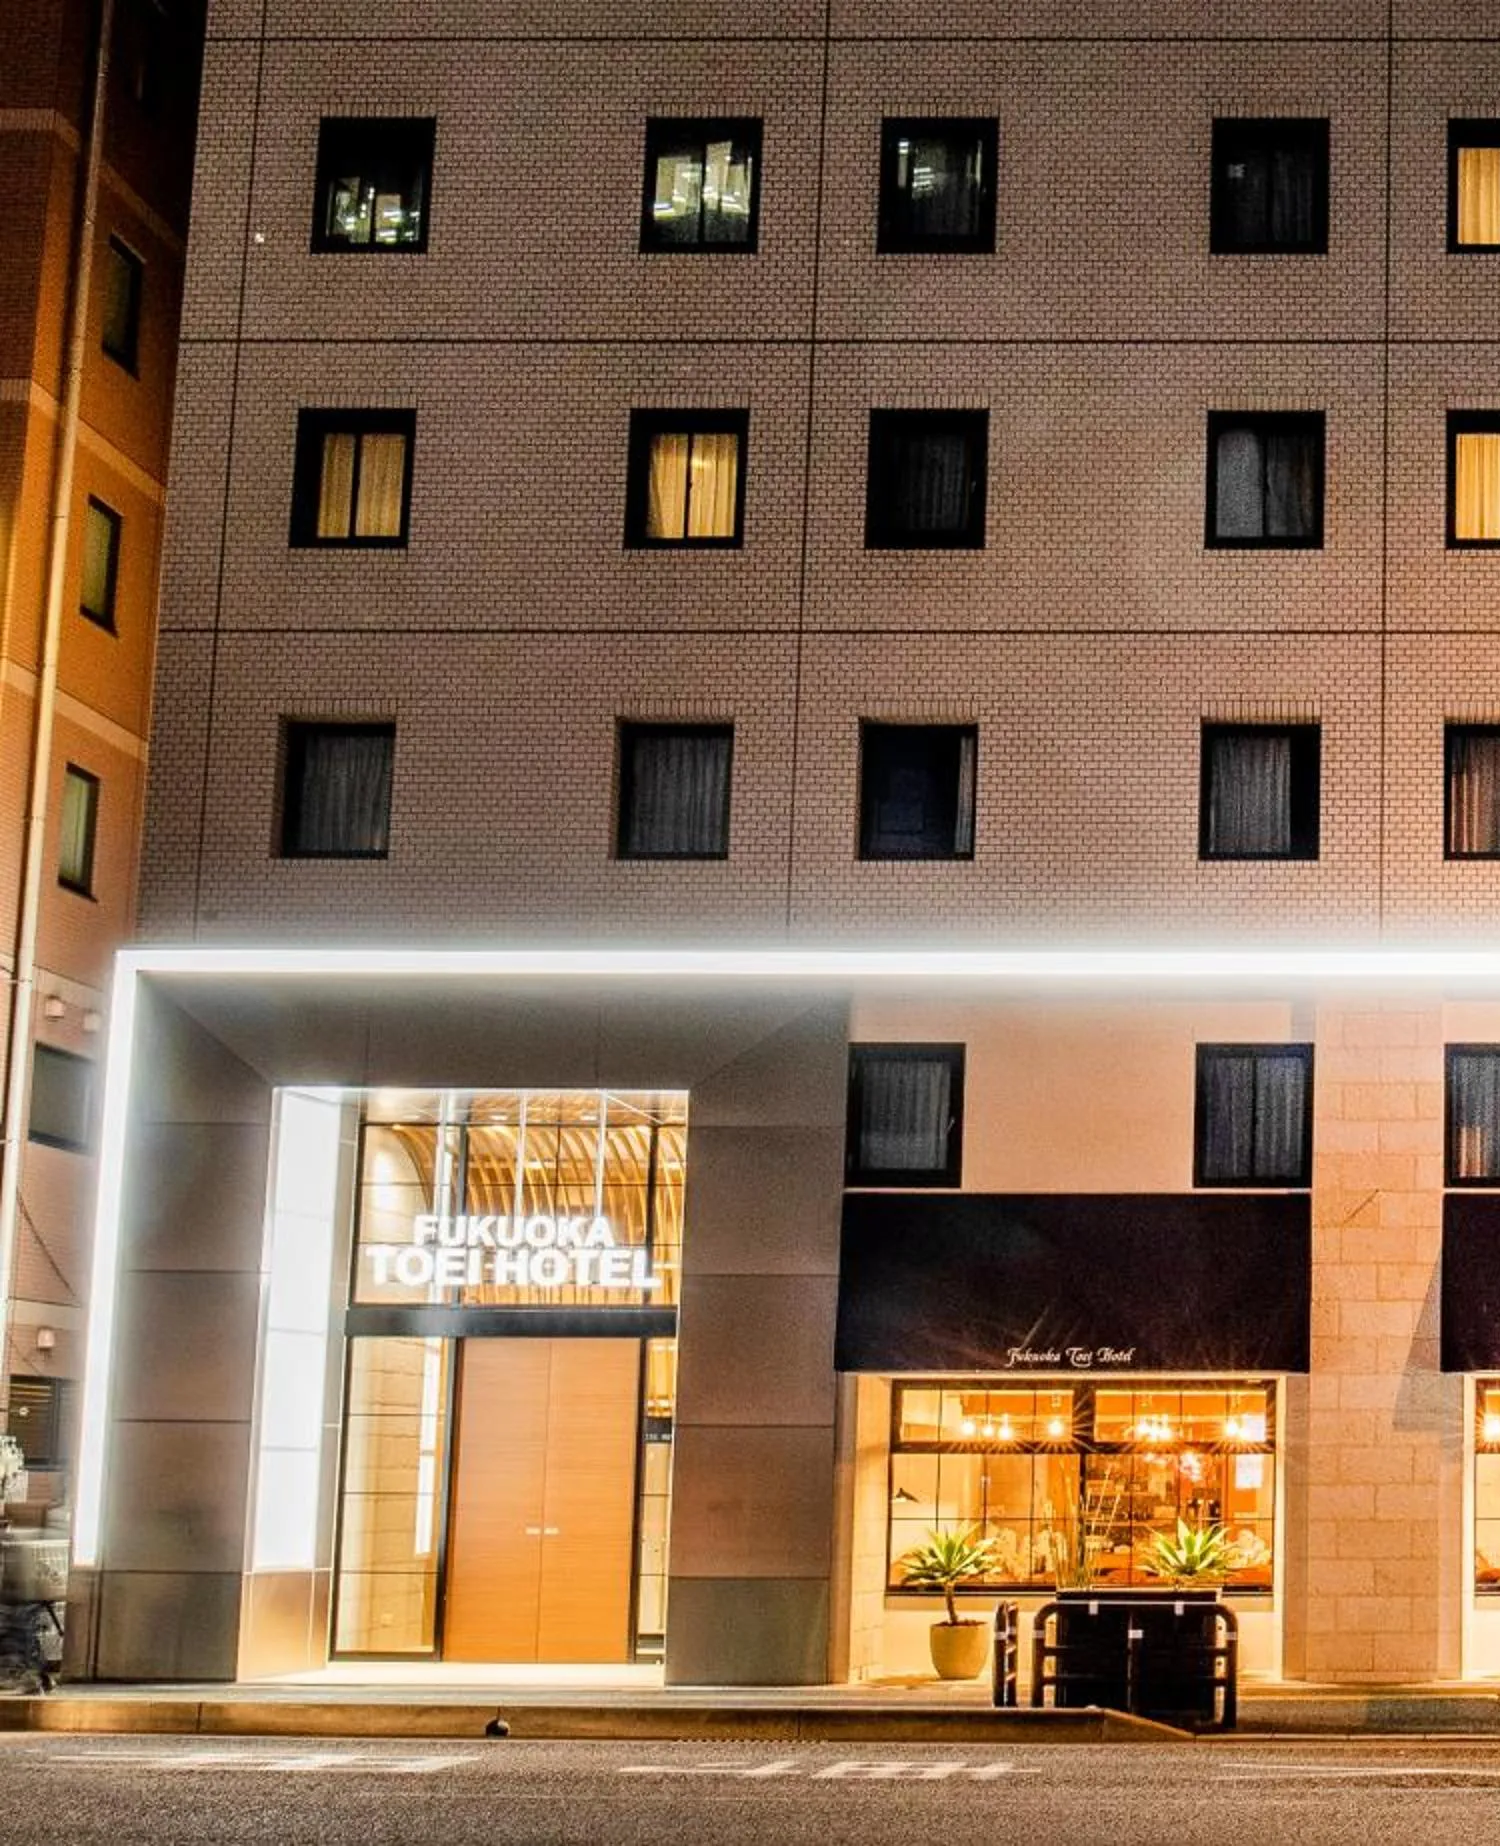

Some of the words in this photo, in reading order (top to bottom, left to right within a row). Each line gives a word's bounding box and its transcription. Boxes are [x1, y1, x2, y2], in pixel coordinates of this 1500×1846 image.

[413, 1213, 616, 1248] FUKUOKA
[365, 1244, 481, 1287] TOEI
[497, 1247, 662, 1289] HOTEL
